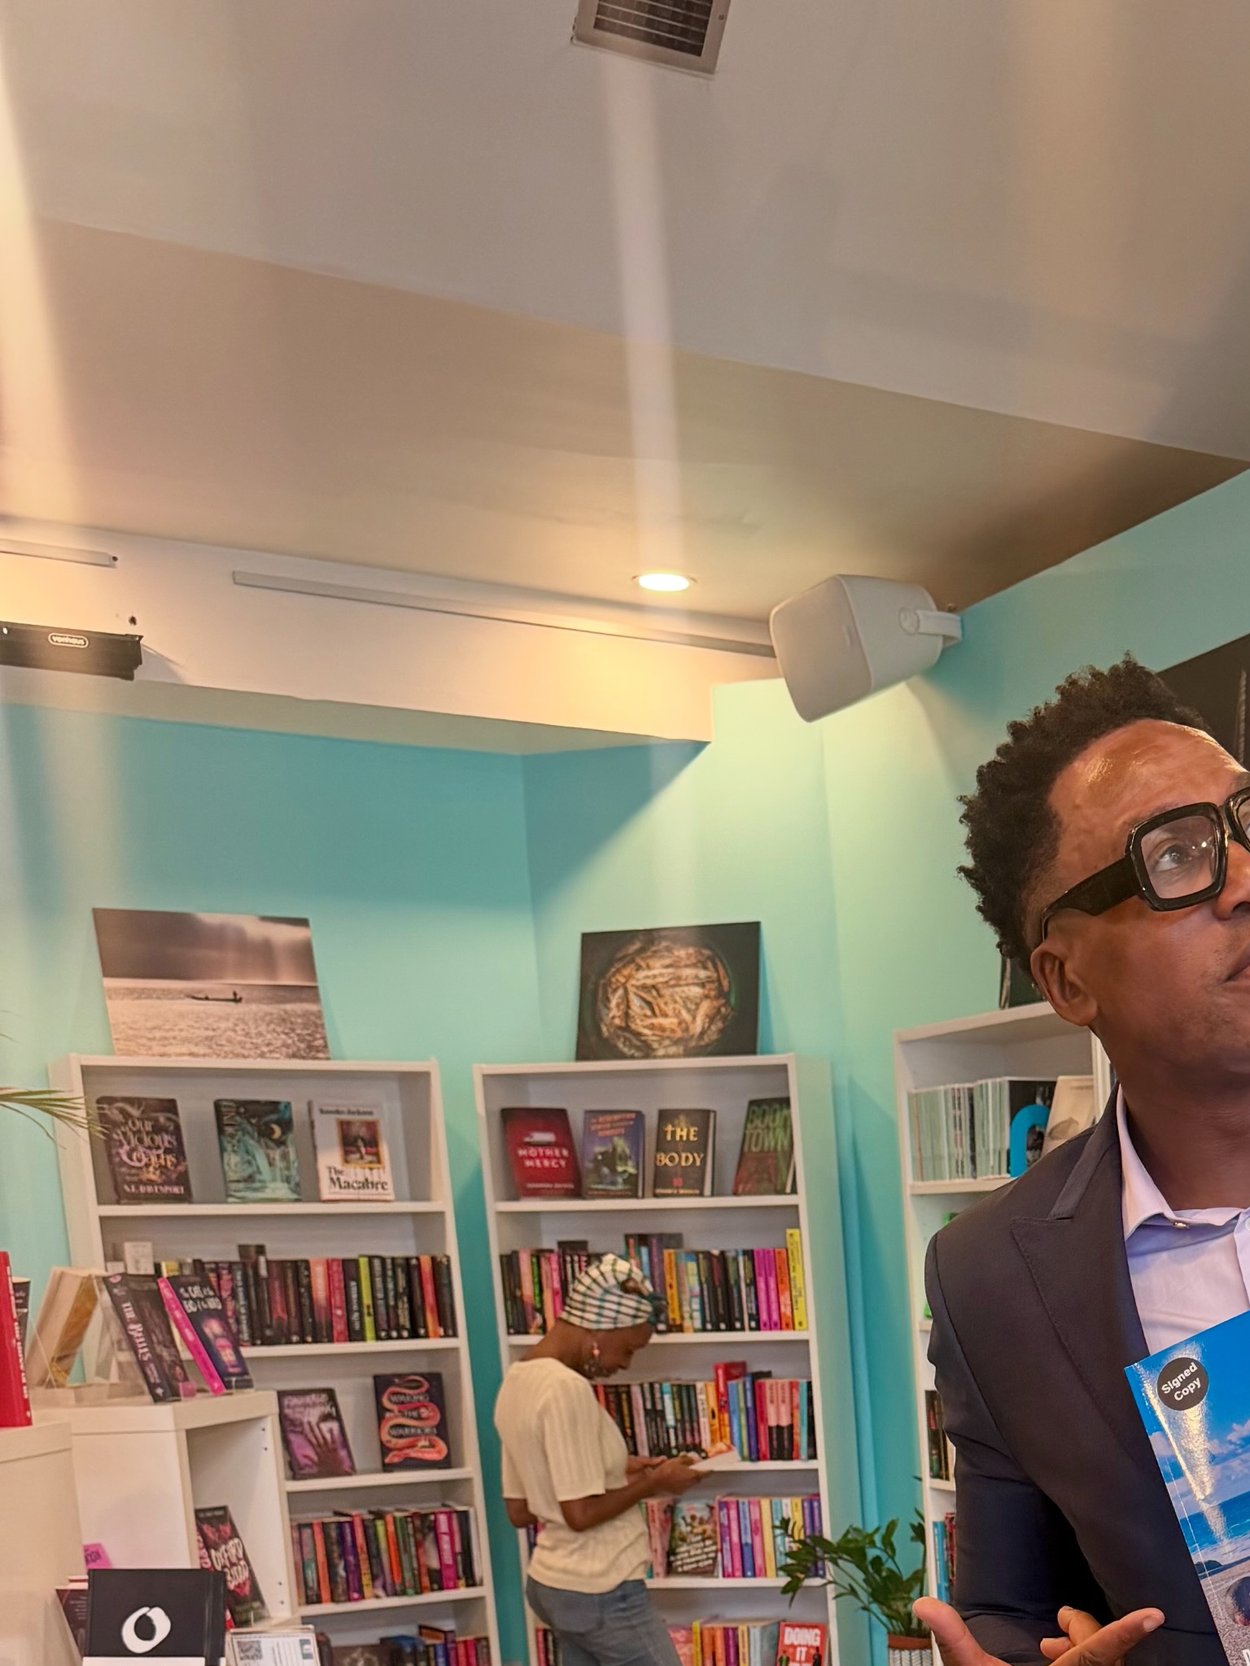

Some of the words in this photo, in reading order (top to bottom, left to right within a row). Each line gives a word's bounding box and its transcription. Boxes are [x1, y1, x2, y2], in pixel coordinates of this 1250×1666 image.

[664, 1123, 699, 1142] THE
[518, 1147, 570, 1159] MOTHER
[655, 1152, 704, 1168] BODY
[327, 1165, 345, 1178] The
[523, 1158, 567, 1169] MERCY
[328, 1176, 389, 1192] Macabre
[1161, 1362, 1198, 1394] Signed
[1174, 1377, 1201, 1401] Copy
[783, 1628, 820, 1646] DOING
